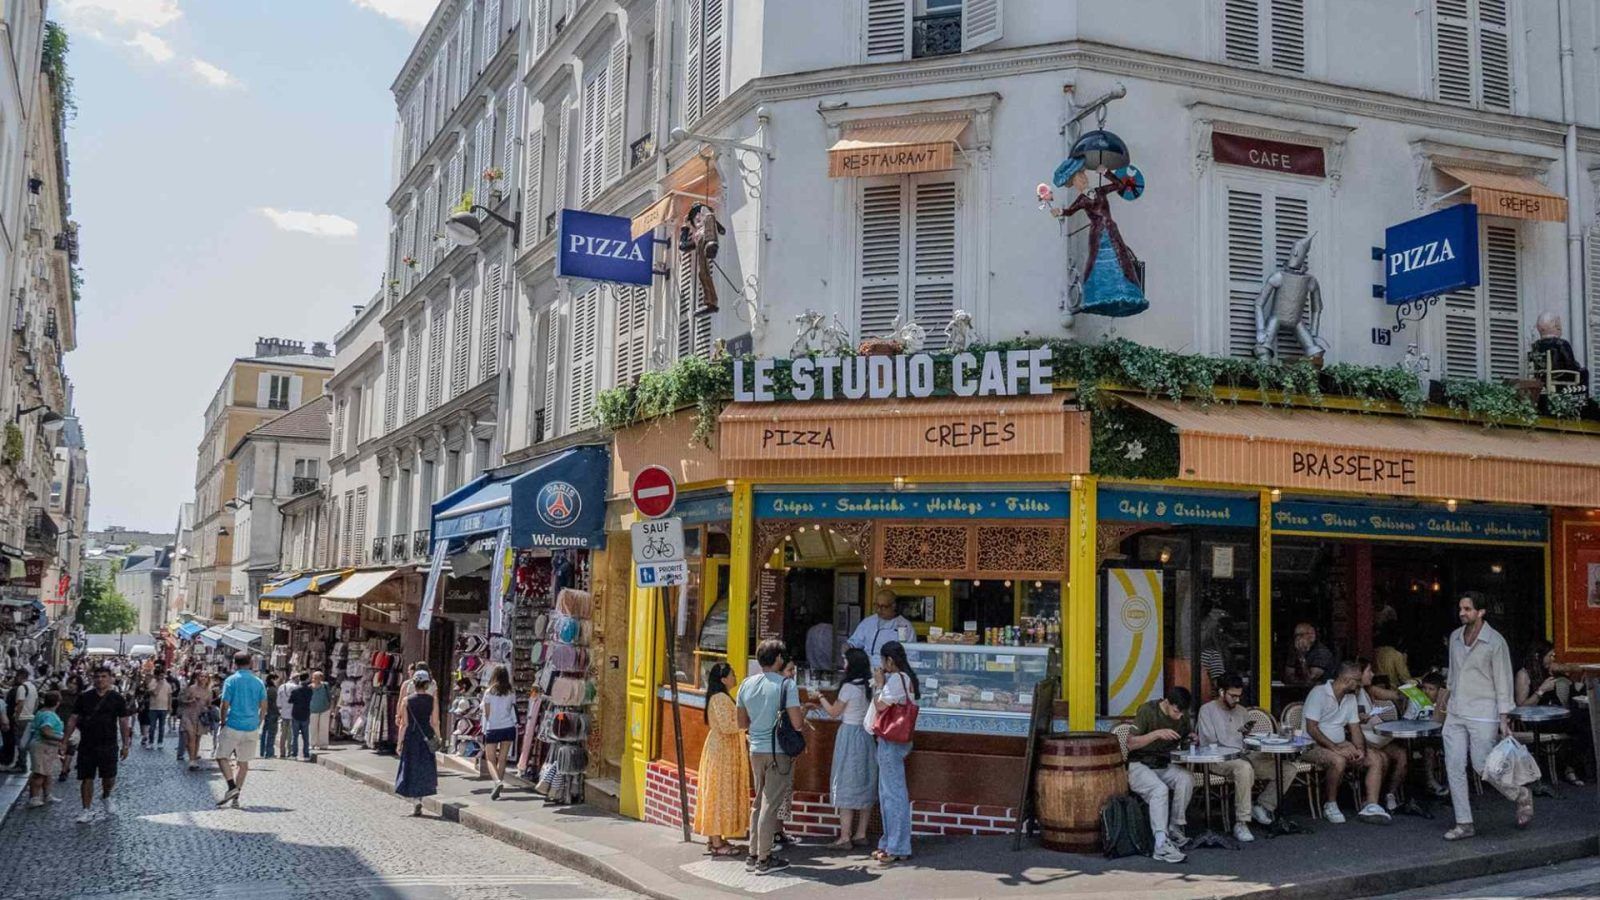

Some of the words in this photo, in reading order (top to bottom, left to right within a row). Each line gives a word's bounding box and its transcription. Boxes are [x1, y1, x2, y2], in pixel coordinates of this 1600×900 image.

[843, 149, 937, 170] RESTAURANT
[1248, 148, 1292, 169] CAFE
[1499, 196, 1541, 213] CREPES
[569, 233, 646, 262] PIZZA
[1389, 237, 1455, 277] PIZZA
[1375, 329, 1388, 344] 15
[733, 359, 775, 402] LE
[791, 353, 935, 401] STUDIO
[952, 345, 1053, 397] CAFÉ
[763, 427, 835, 450] PIZZA
[924, 421, 1016, 447] CREPES
[1293, 451, 1416, 485] BRASSERIE
[546, 484, 576, 497] PARIS
[926, 497, 983, 515] Hotdogs
[1119, 499, 1150, 518] Café
[1155, 501, 1167, 516] &
[1174, 502, 1232, 520] Croissant
[642, 522, 670, 534] SAUF
[1275, 510, 1309, 525] Pizza
[1369, 515, 1416, 530] Boissons
[1427, 518, 1473, 533] Cocktails
[532, 533, 588, 547] Welcome
